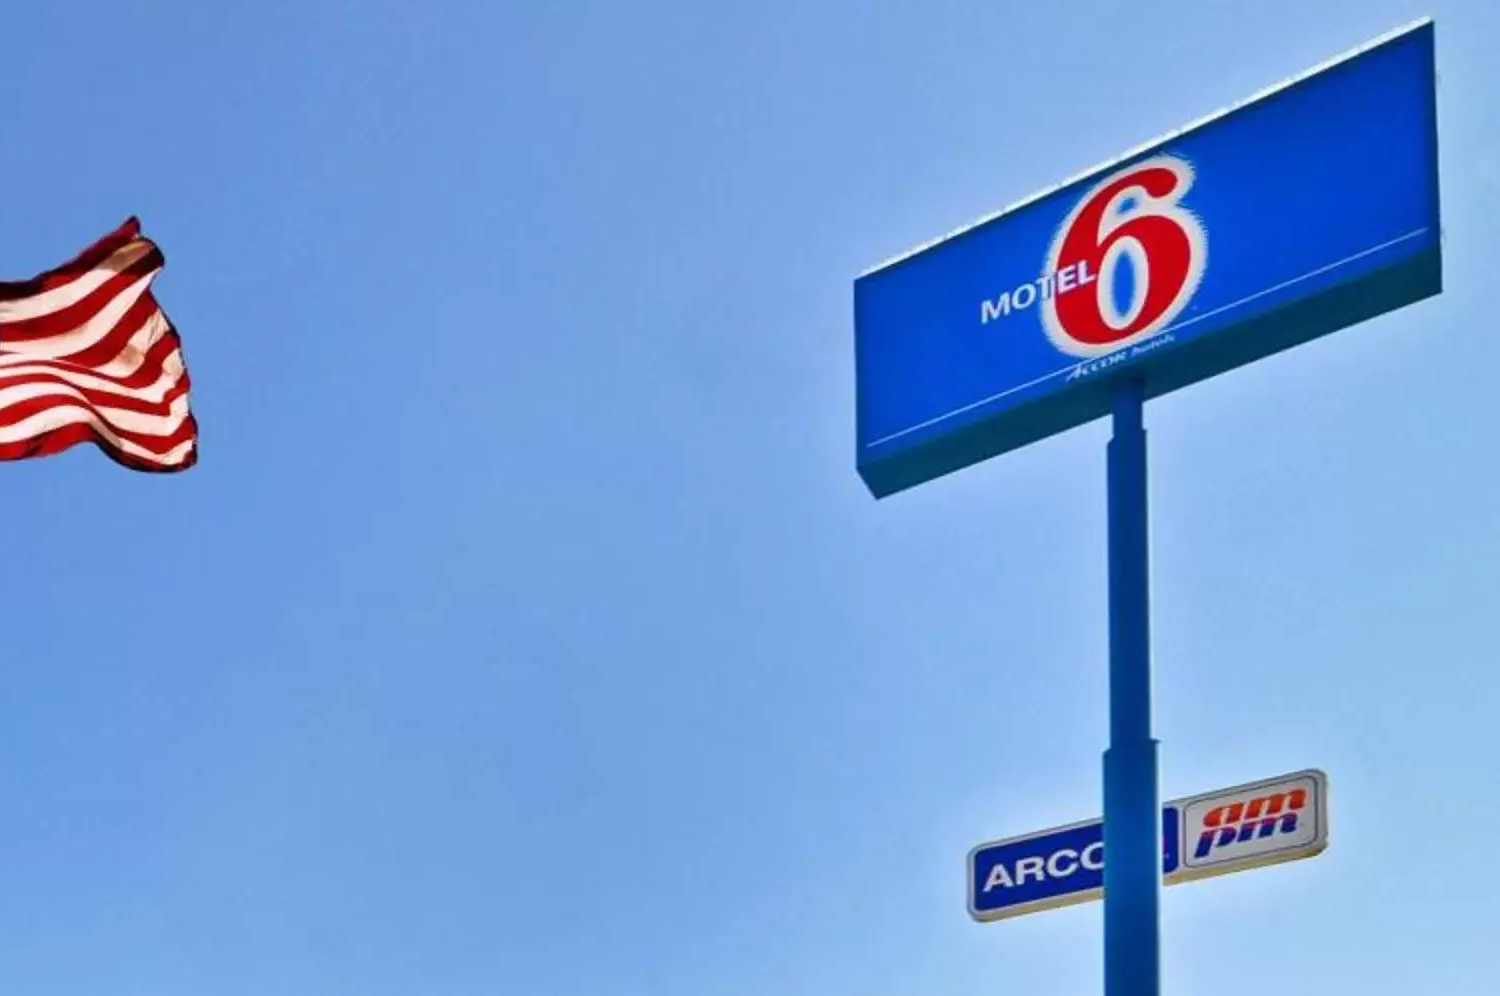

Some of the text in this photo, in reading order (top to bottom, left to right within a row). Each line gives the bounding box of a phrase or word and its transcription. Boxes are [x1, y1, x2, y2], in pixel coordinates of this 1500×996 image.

[980, 165, 1193, 347] MOTEL 6
[1202, 788, 1307, 827] am
[1194, 811, 1299, 859] pm
[982, 841, 1104, 893] ARCO
